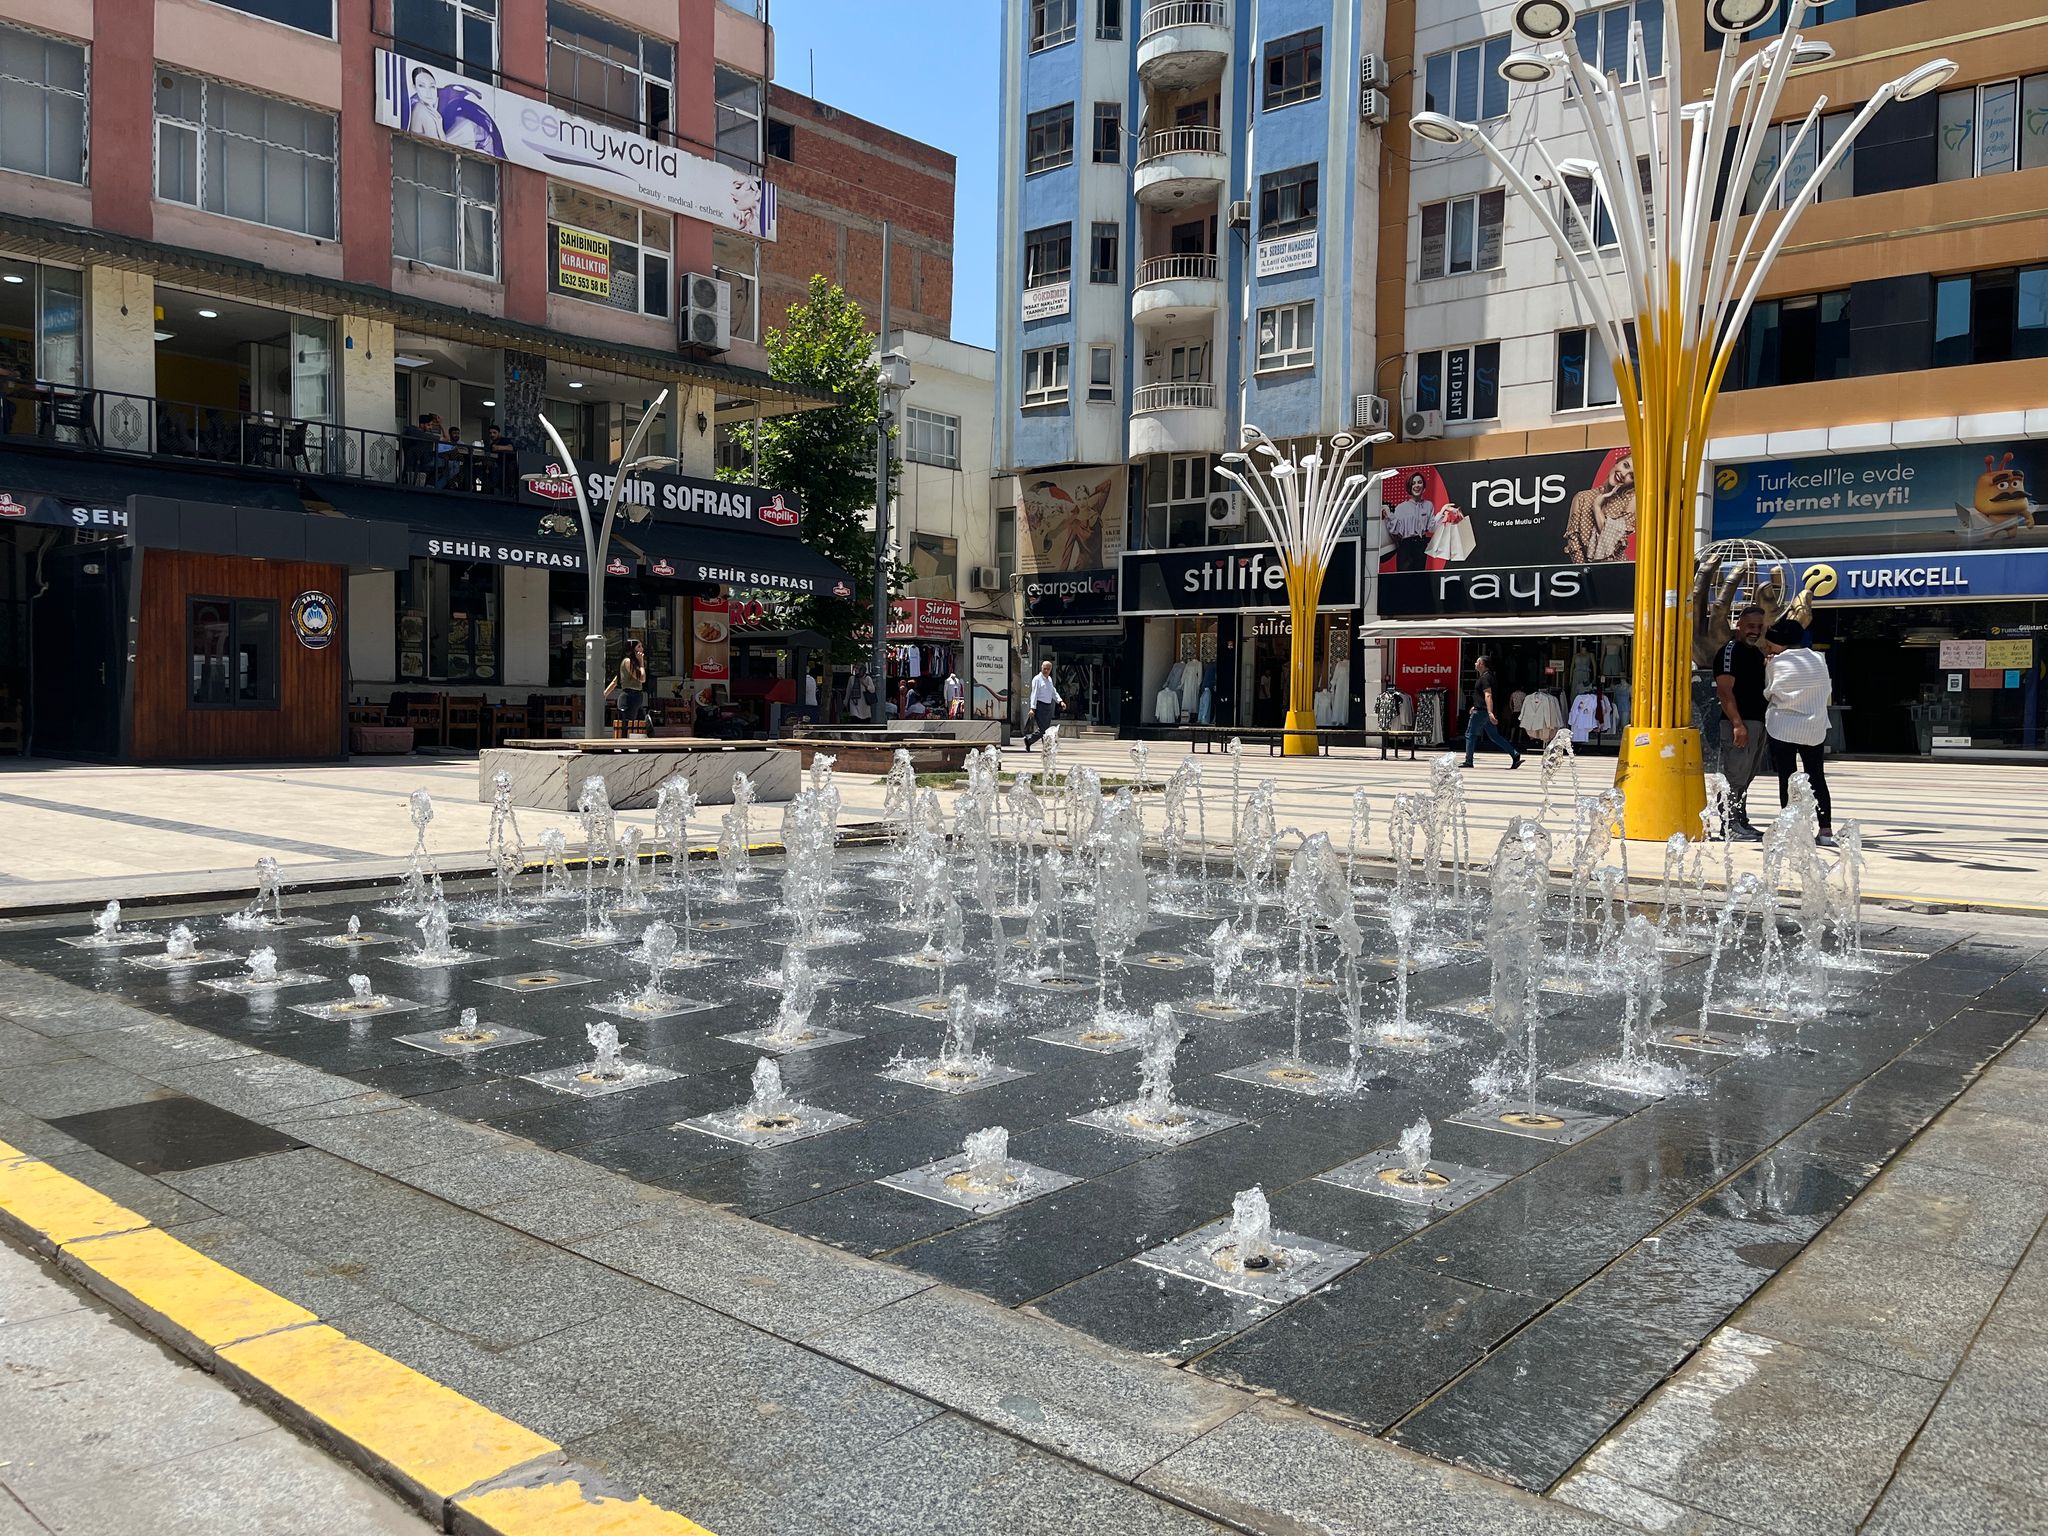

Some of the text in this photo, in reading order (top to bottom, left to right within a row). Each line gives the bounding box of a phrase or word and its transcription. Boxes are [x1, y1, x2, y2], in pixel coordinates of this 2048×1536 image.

[638, 184, 724, 219] beauty medical esthetic
[560, 231, 608, 256] SAHİBİNDEN
[561, 272, 608, 294] 0532 553 58 85
[1450, 381, 1463, 415] DENT
[1862, 463, 1915, 483] evde
[662, 483, 752, 519] SOFRASI
[1471, 474, 1566, 514] rays
[1755, 486, 1910, 514] internet keyfi!
[72, 507, 128, 526] ŞEH
[428, 539, 581, 568] ŞEHİR SOFRASI
[698, 566, 814, 591] ŞEHİR SOFRASI
[1184, 553, 1285, 592] stilife
[1847, 566, 1969, 588] TURKCELL
[1439, 570, 1581, 607] rays
[919, 614, 958, 626] Collection
[925, 602, 952, 616] Şirin
[1251, 620, 1292, 636] stilife
[1401, 663, 1452, 674] İNDİRİM
